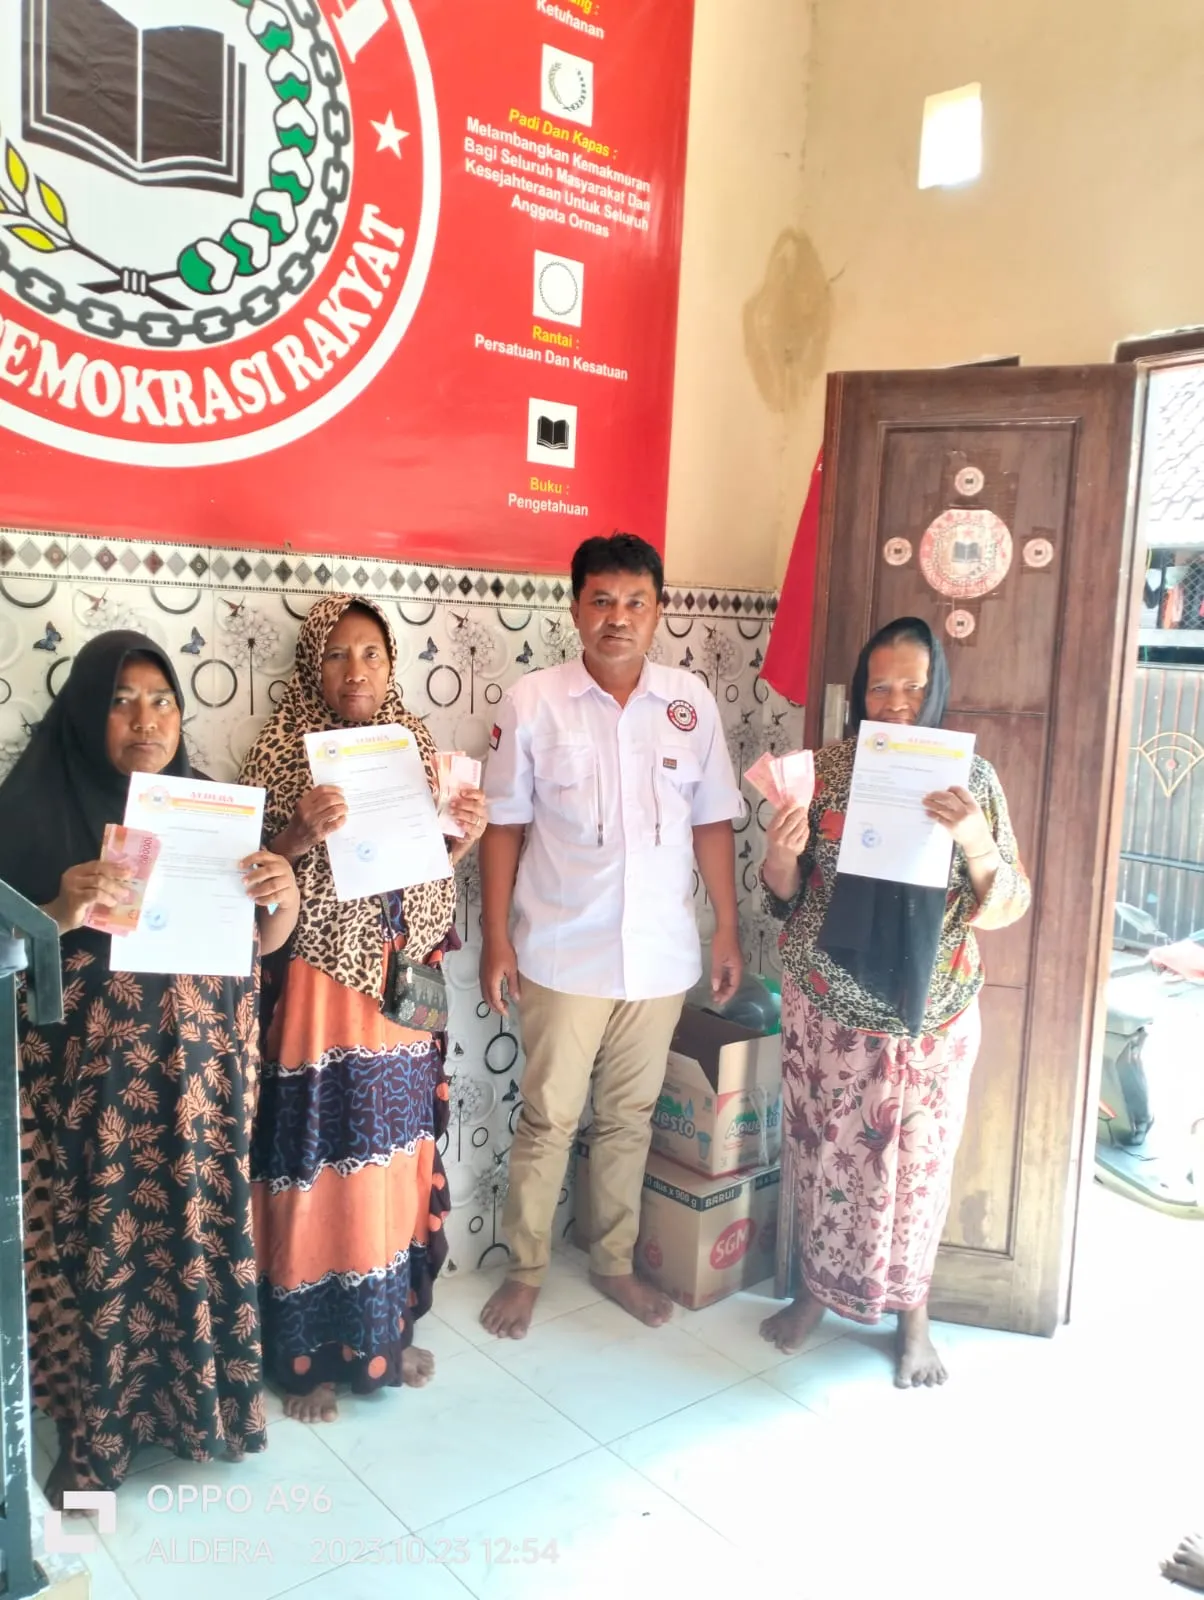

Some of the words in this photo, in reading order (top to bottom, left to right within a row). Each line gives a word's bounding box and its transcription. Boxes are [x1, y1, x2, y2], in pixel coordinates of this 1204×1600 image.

[536, 0, 604, 39] Ketuhanan
[467, 116, 570, 164] Melambangkan
[572, 152, 651, 193] Kemakmuran
[508, 108, 540, 131] Padi
[542, 120, 570, 141] Dan
[572, 131, 610, 157] Kapas
[464, 137, 497, 161] Bagi
[501, 148, 553, 178] Seluruh
[556, 167, 625, 205] Masyarakat
[628, 191, 650, 212] Dan
[464, 157, 561, 203] Kesejahteraan
[564, 190, 601, 215] Untuk
[604, 204, 649, 232] Seluruh
[511, 194, 565, 224] Anggota
[568, 214, 609, 238] Ormas
[272, 203, 405, 391] RAKYAT
[474, 333, 542, 362] Persatuan
[545, 350, 569, 368] Dan
[573, 356, 628, 381] Kesatuan
[532, 325, 573, 348] Rantai
[508, 493, 589, 516] Pengetahuan
[529, 477, 563, 494] Buku
